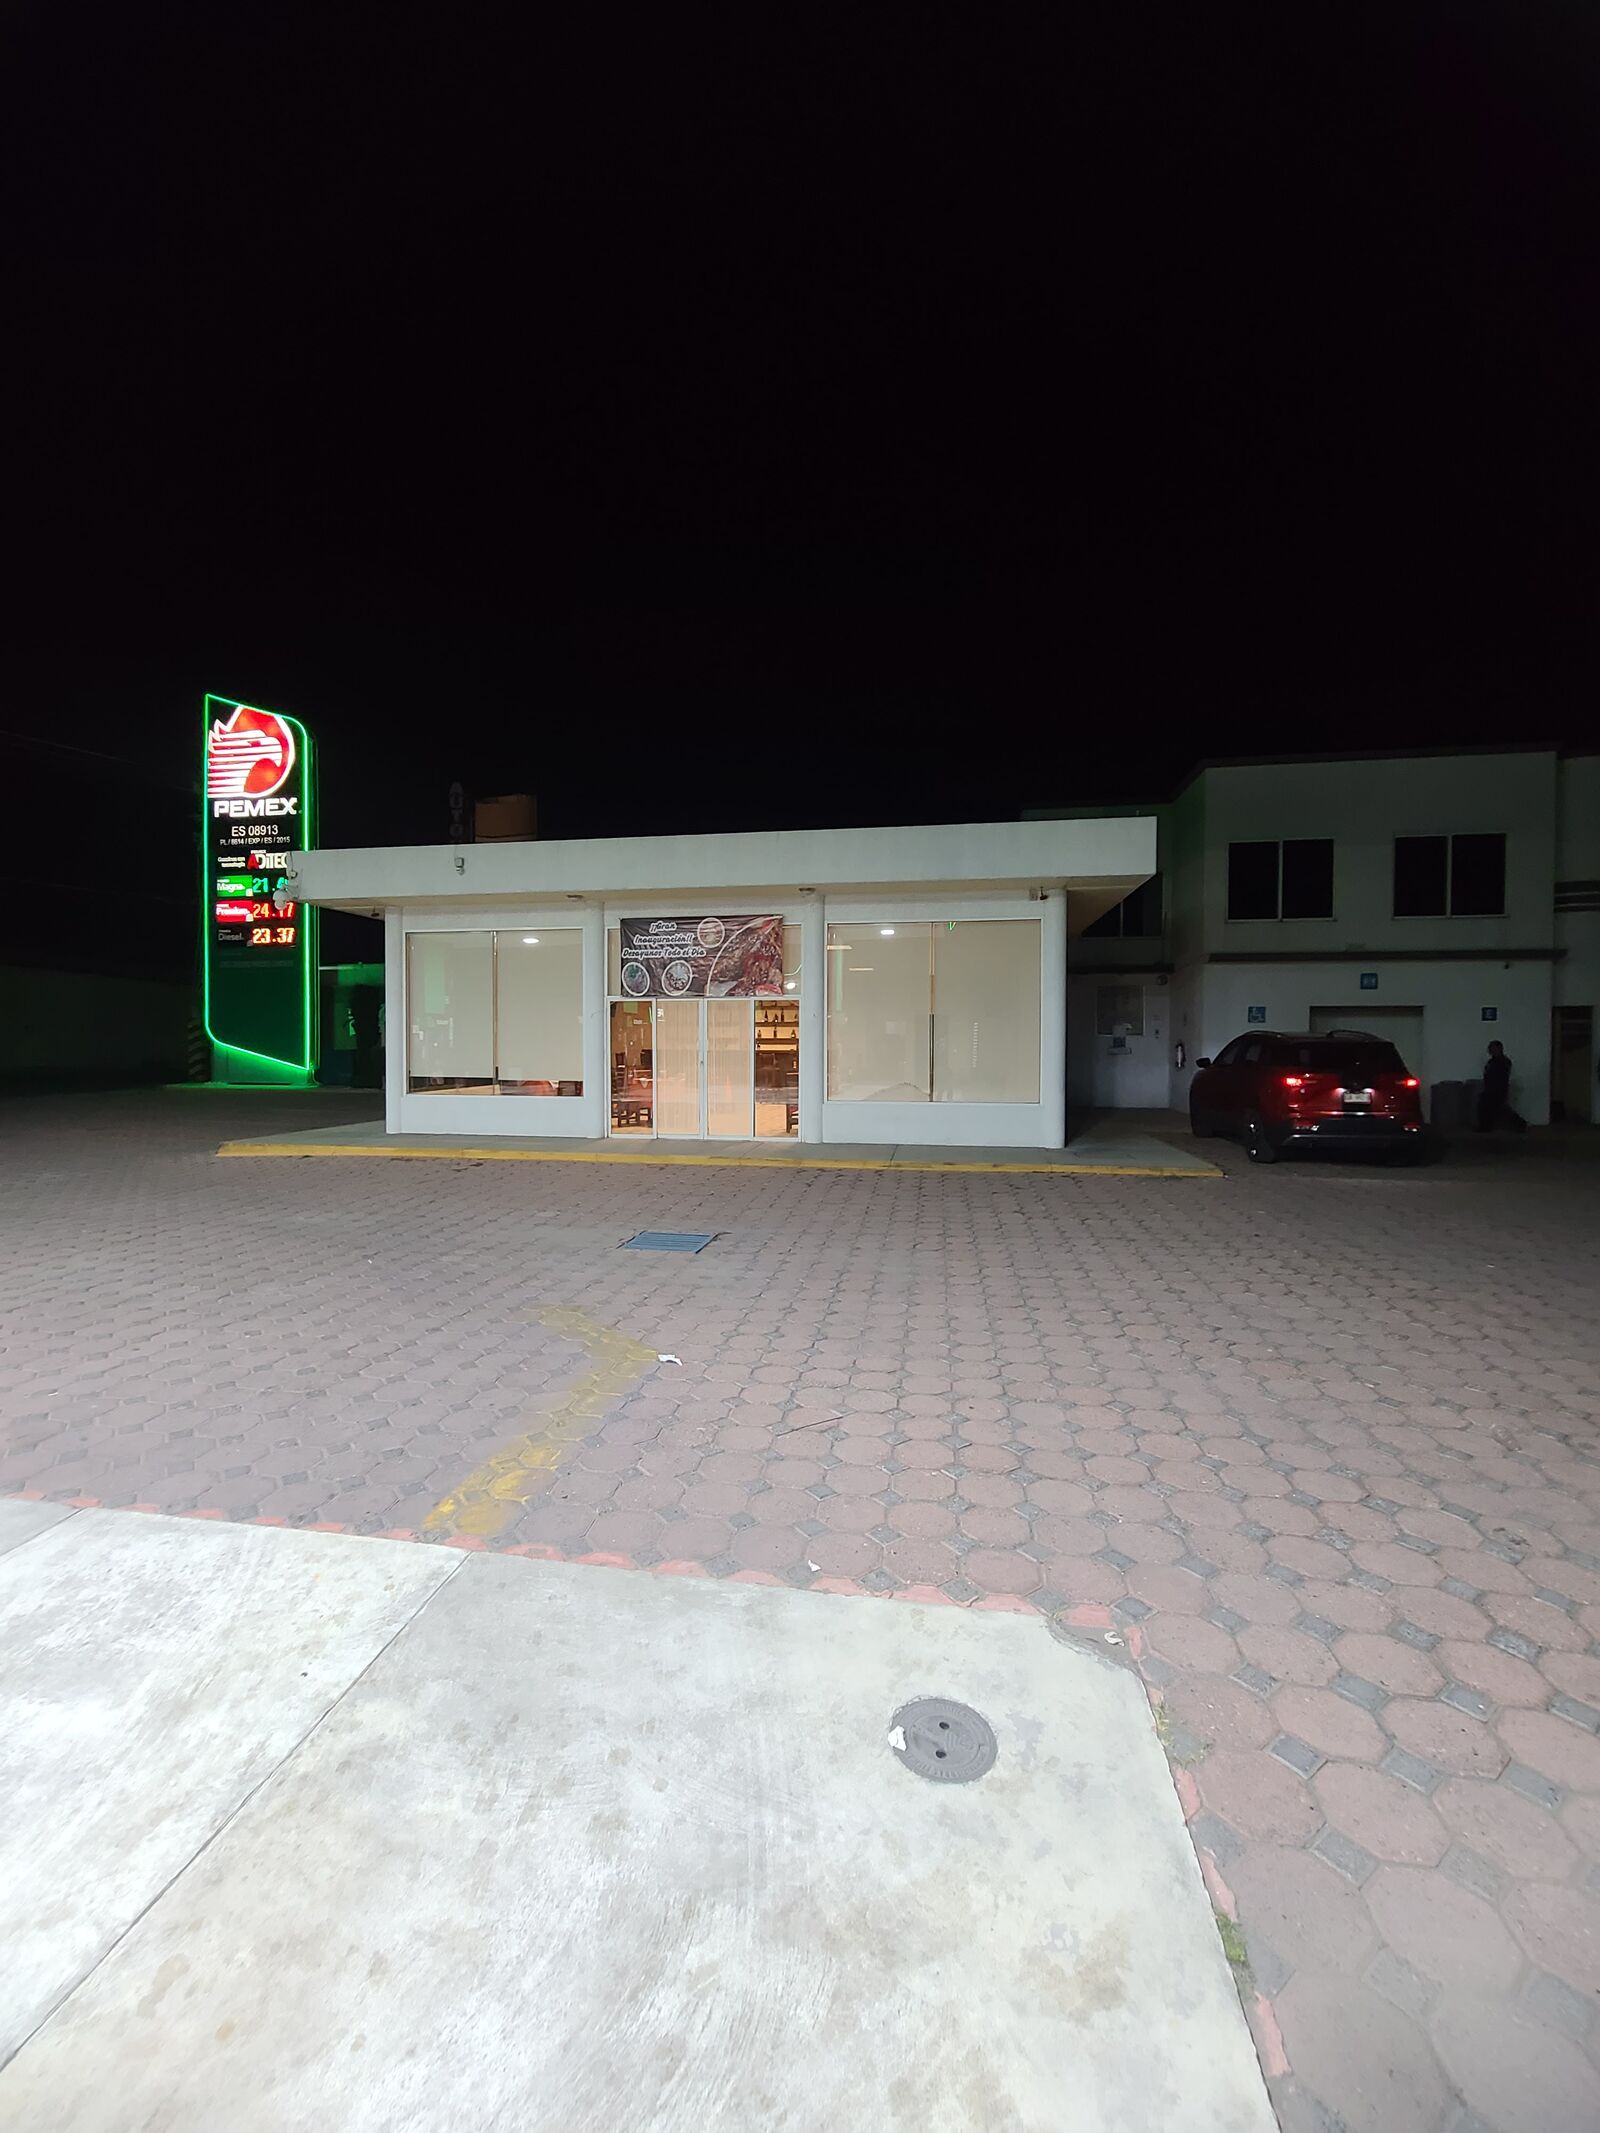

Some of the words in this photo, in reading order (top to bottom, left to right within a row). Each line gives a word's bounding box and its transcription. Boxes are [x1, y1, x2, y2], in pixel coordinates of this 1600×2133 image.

[214, 797, 298, 818] PEMEX
[231, 826, 246, 837] ES
[248, 824, 279, 836] 08913
[252, 928, 295, 944] 23.37
[623, 948, 662, 959] Desayunos
[664, 948, 681, 957] Todo
[682, 947, 690, 957] el
